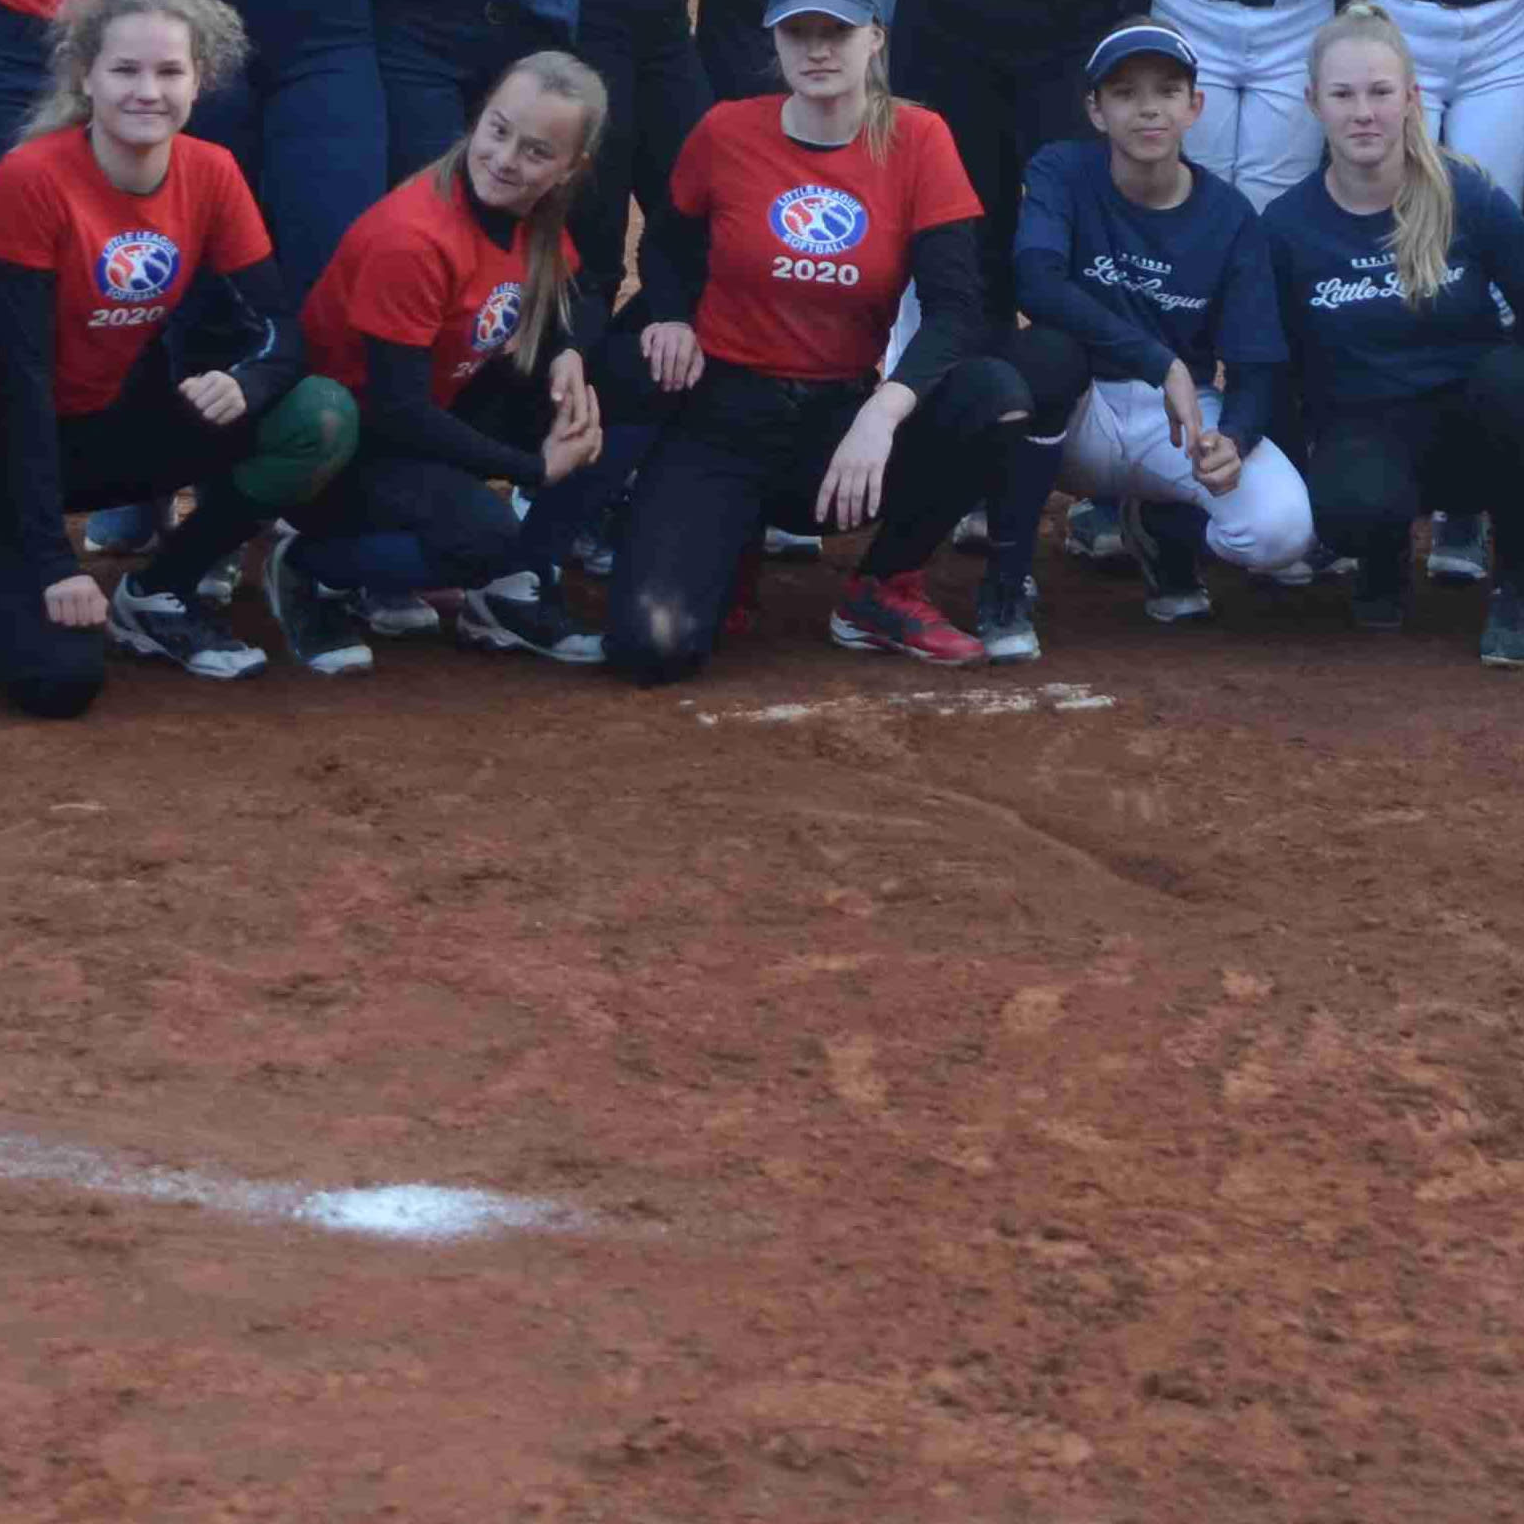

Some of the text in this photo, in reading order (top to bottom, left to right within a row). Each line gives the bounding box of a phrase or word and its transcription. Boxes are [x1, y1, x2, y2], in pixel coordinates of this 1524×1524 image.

[777, 185, 863, 214] LITTLE LEAGUE
[782, 233, 851, 254] SOFTBALL
[772, 256, 860, 286] 2020
[1309, 277, 1379, 309] Little
[88, 305, 167, 327] 2020
